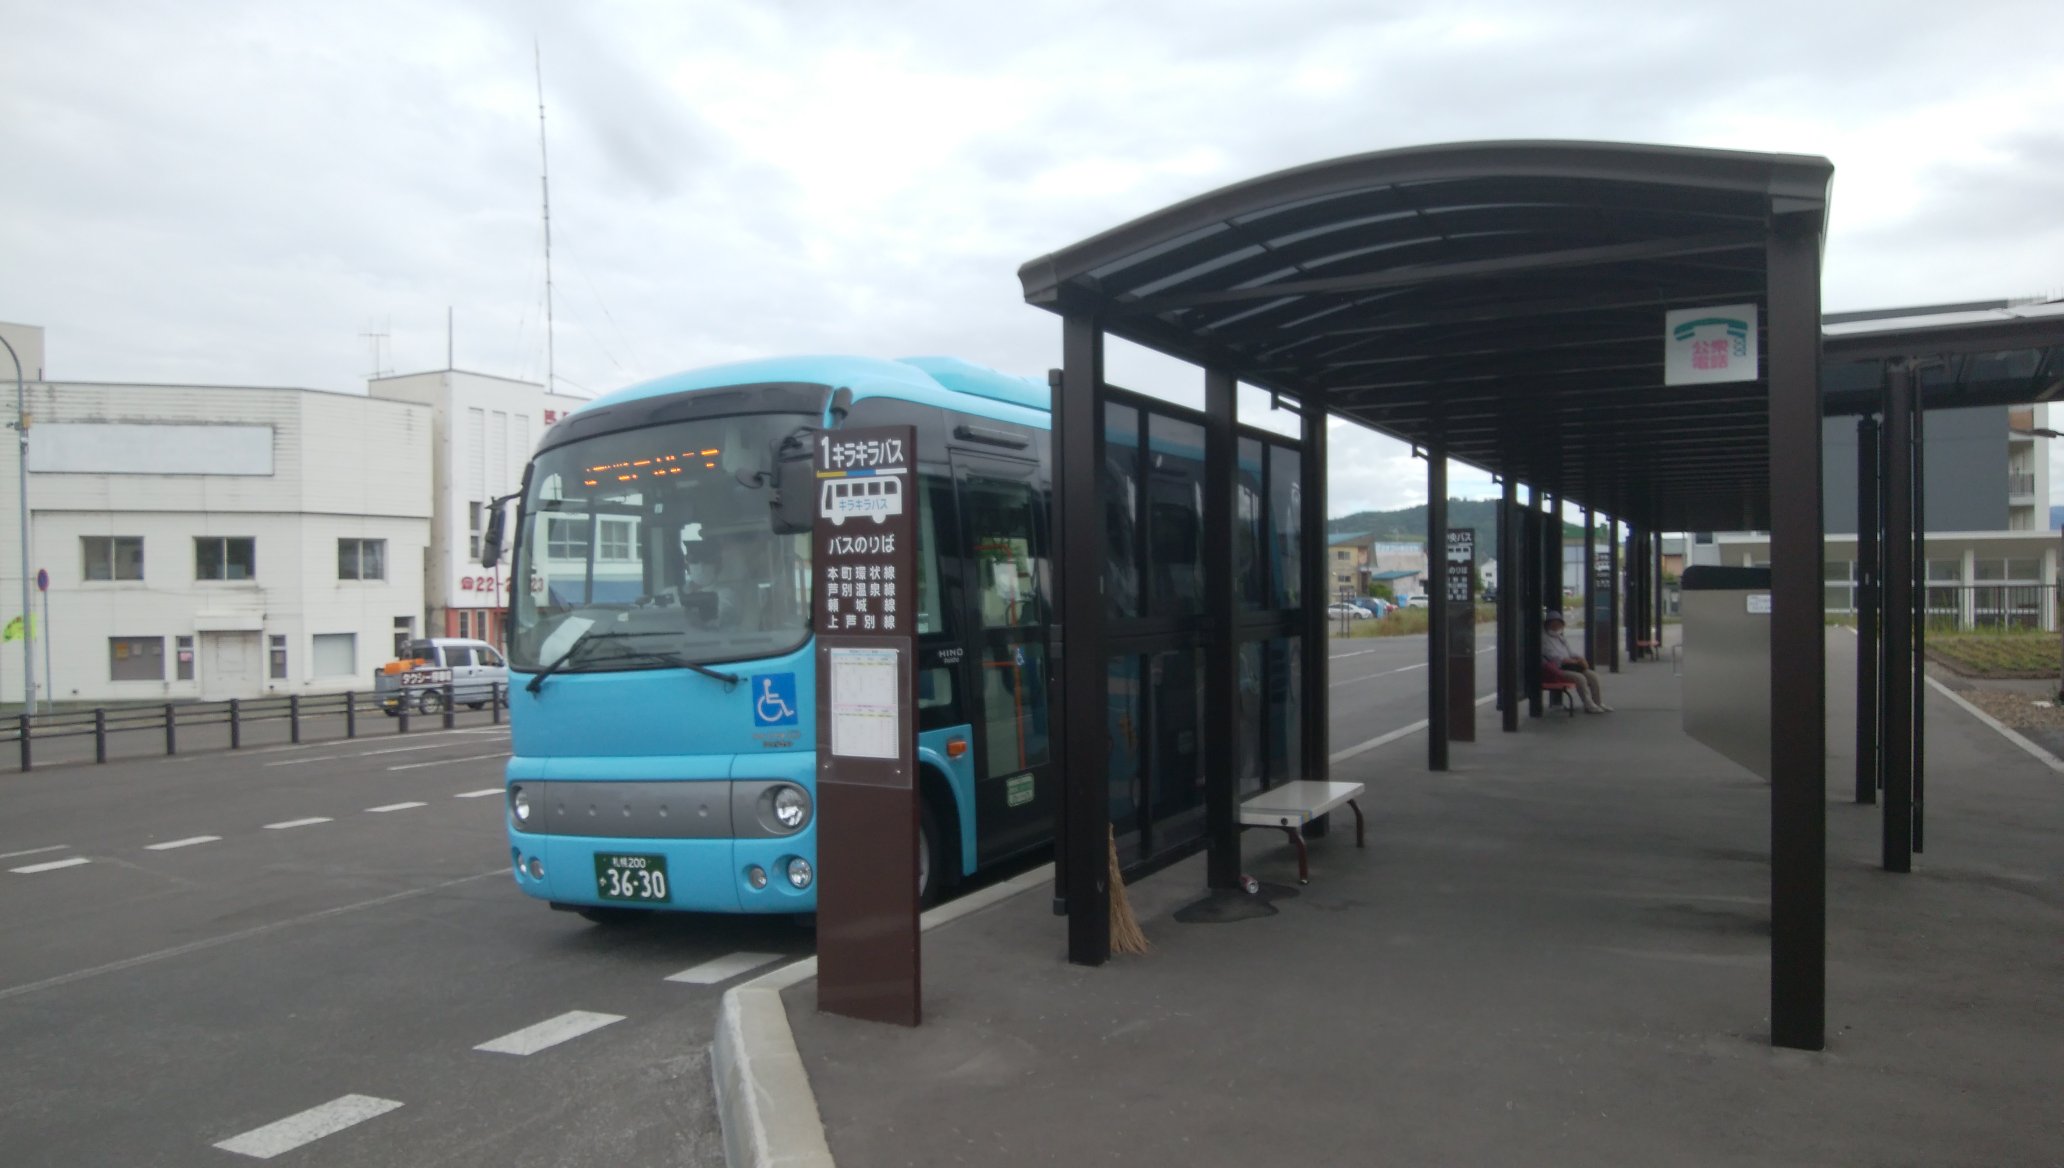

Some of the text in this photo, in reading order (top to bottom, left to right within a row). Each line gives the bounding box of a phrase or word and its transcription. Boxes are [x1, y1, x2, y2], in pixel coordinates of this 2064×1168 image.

[838, 498, 889, 512] キラキラバス
[828, 534, 896, 556] バスのりば
[827, 565, 896, 581] 本町環状線
[827, 582, 896, 597] 芦別温泉線
[827, 614, 896, 629] 上芦別線
[402, 671, 452, 684] タクシー
[607, 868, 666, 898] 36-30
